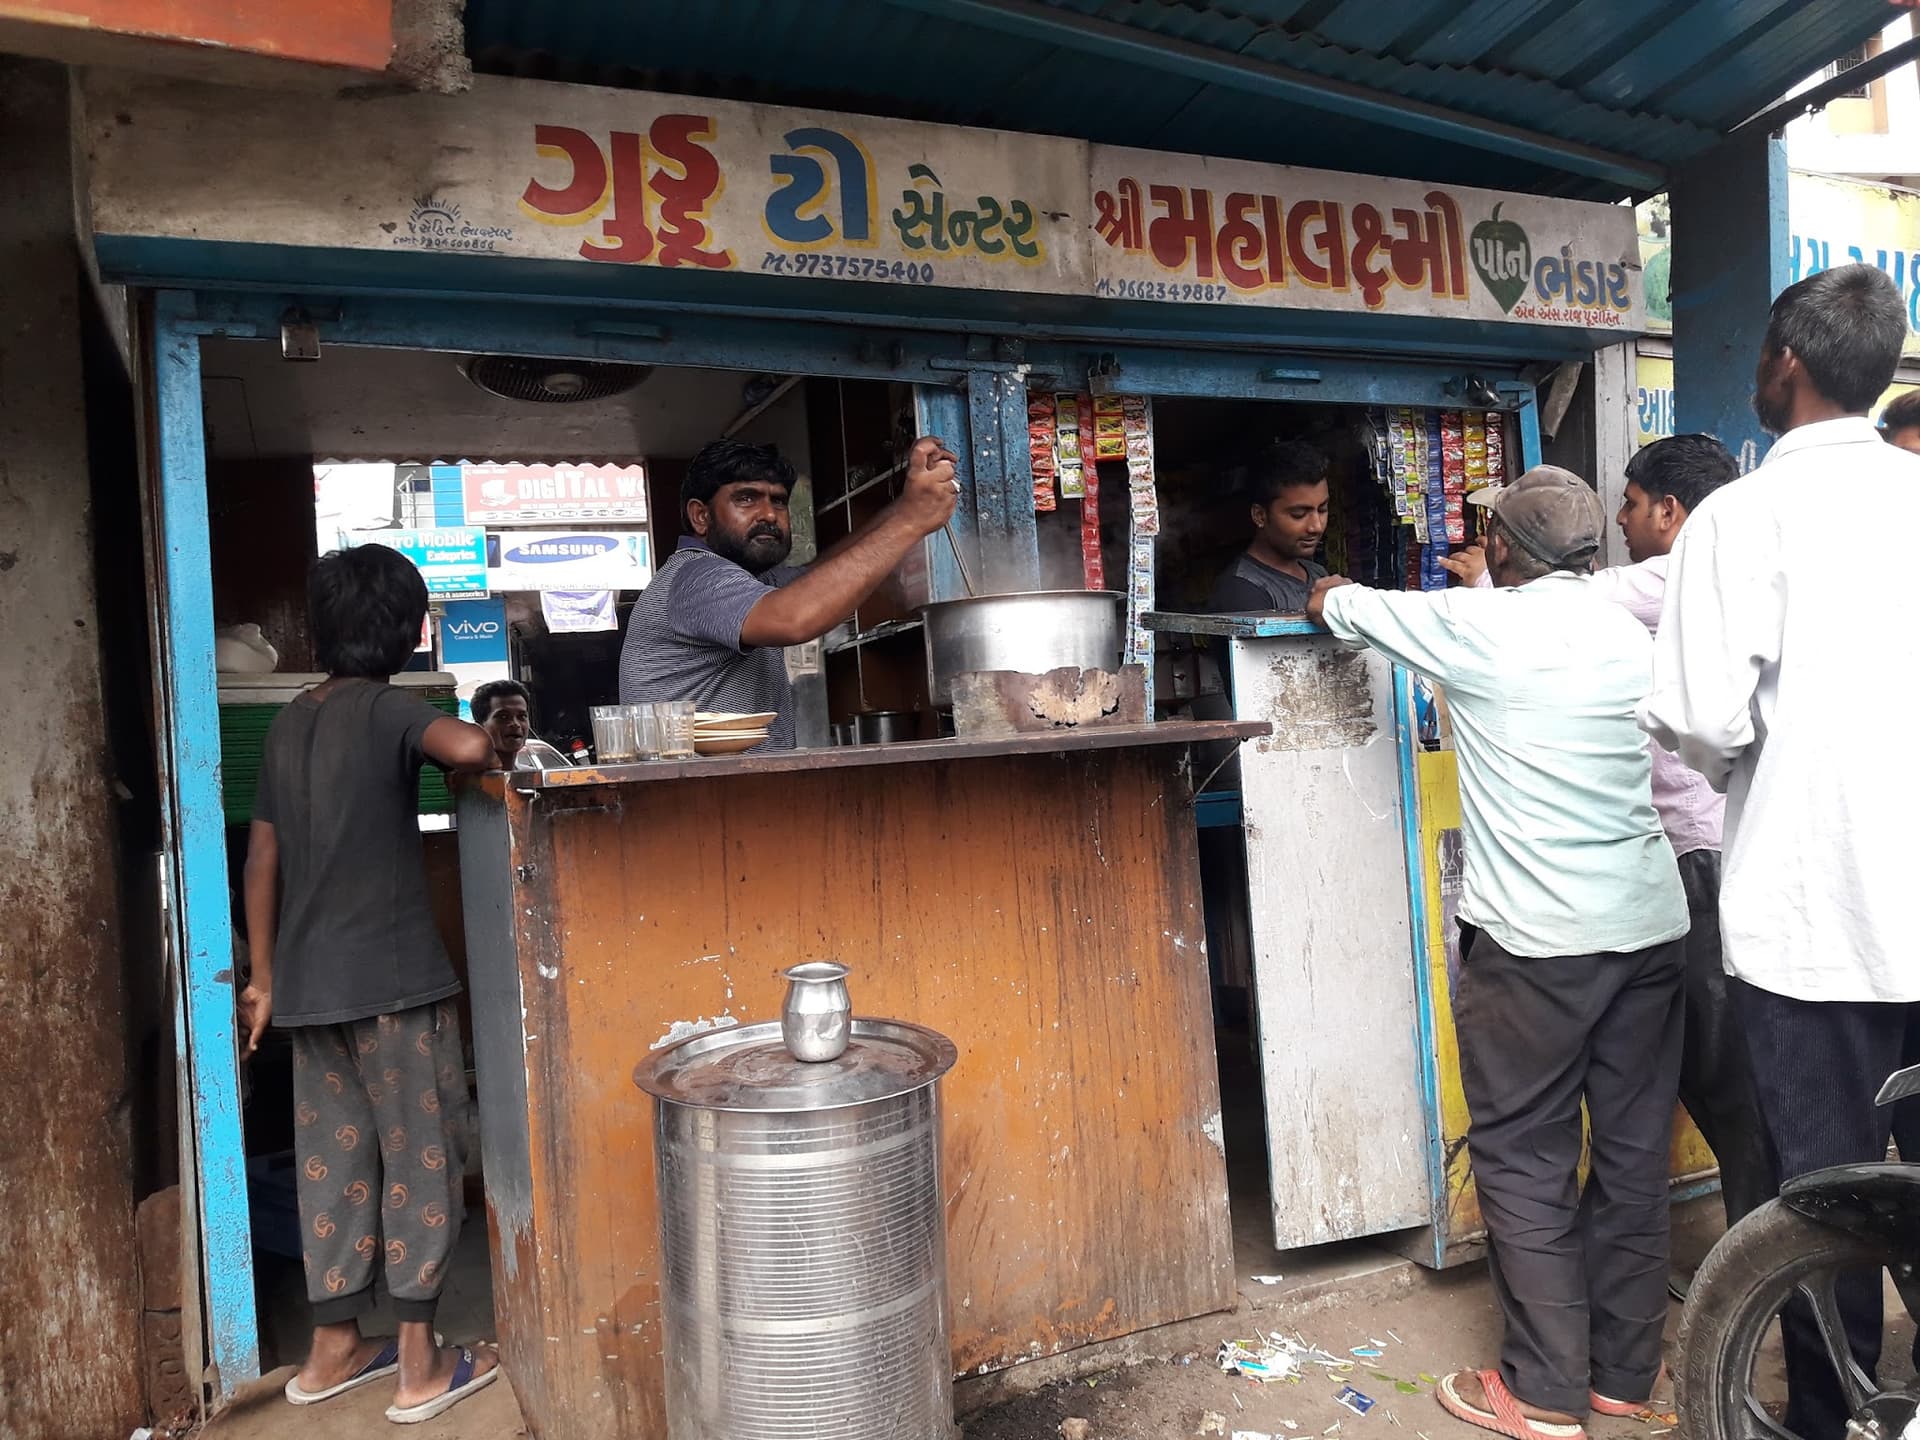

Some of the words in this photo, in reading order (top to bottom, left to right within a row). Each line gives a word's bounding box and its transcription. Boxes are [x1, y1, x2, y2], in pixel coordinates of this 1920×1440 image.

[764, 126, 872, 245] ટી
[892, 163, 1041, 260] સેન્ટર
[1473, 237, 1530, 283] પાન
[1533, 245, 1632, 310] ભંડાર
[518, 470, 612, 500] DIGITAL
[418, 530, 476, 548] Mobile
[518, 543, 606, 556] SAMSUNG
[447, 619, 500, 634] vivo
